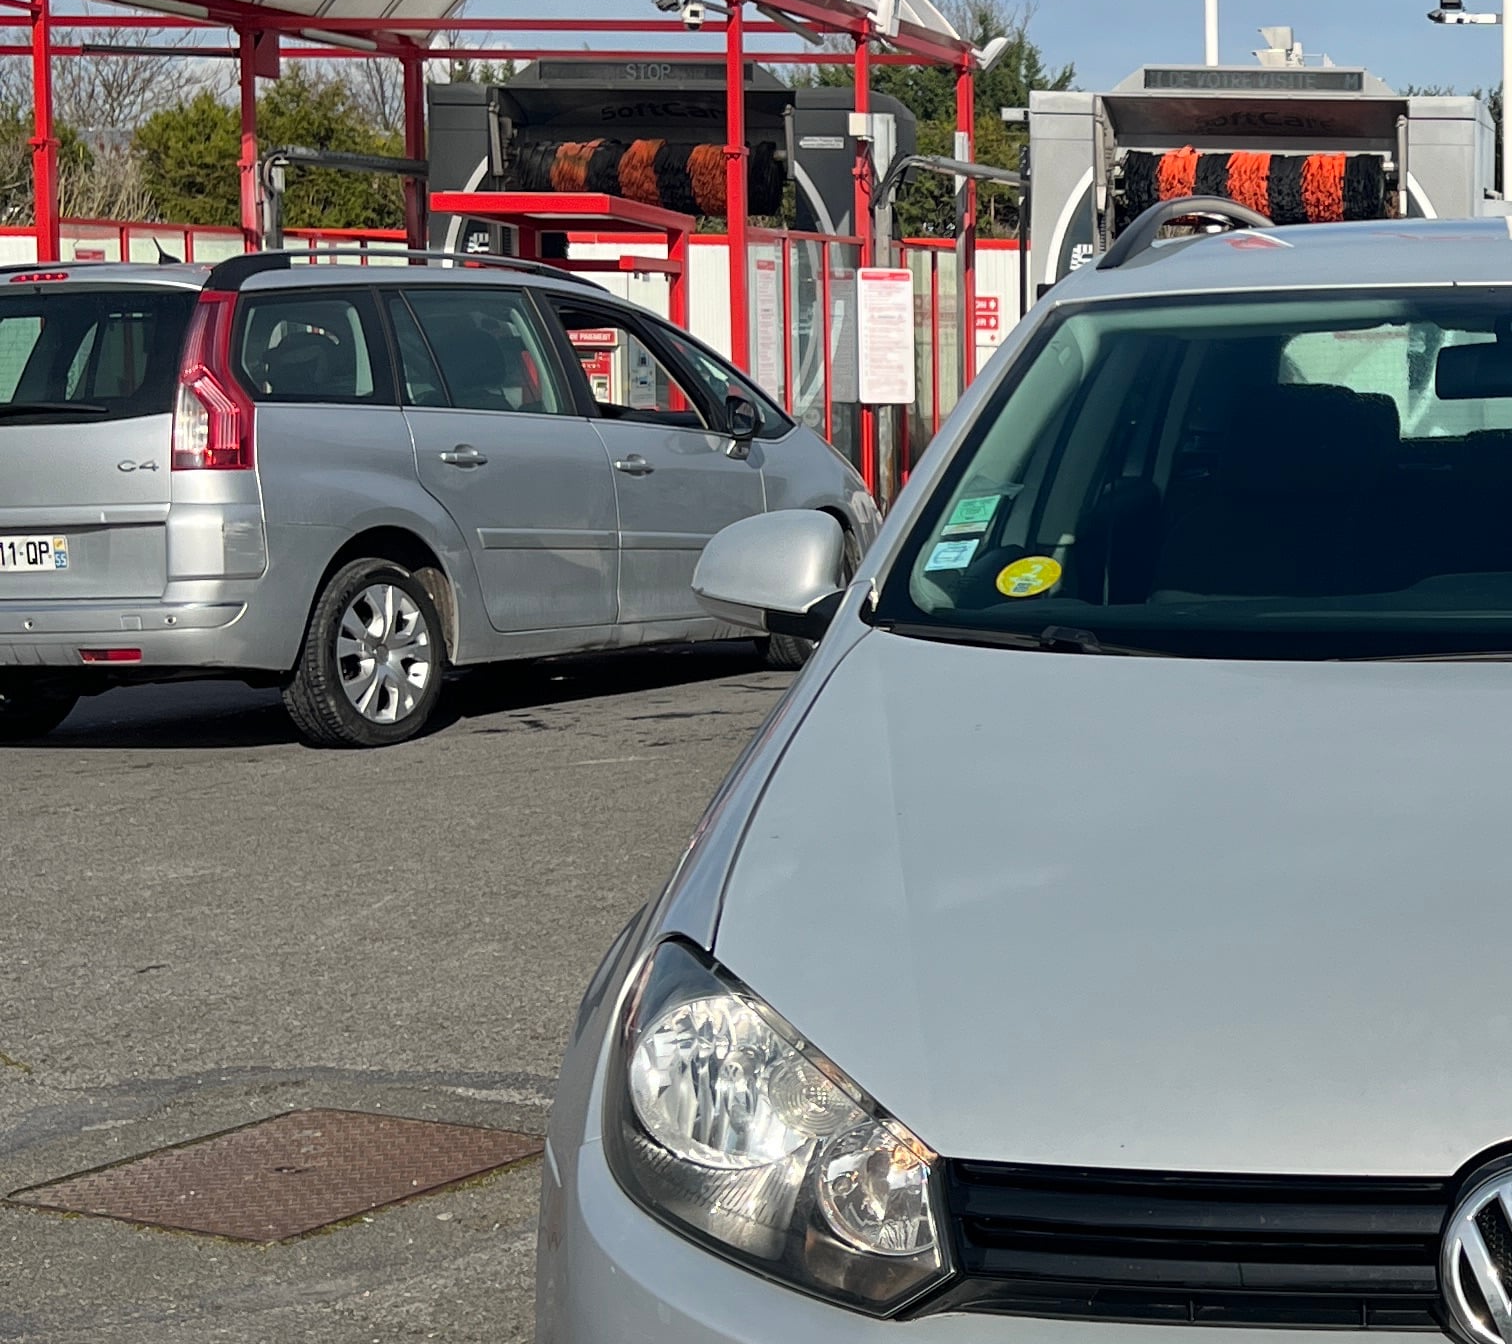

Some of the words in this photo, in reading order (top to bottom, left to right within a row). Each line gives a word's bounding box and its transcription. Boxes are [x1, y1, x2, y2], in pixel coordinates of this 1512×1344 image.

[622, 63, 671, 80] STOP
[1257, 73, 1317, 89] VISITE
[601, 101, 724, 121] SoftCar
[117, 460, 159, 472] C4
